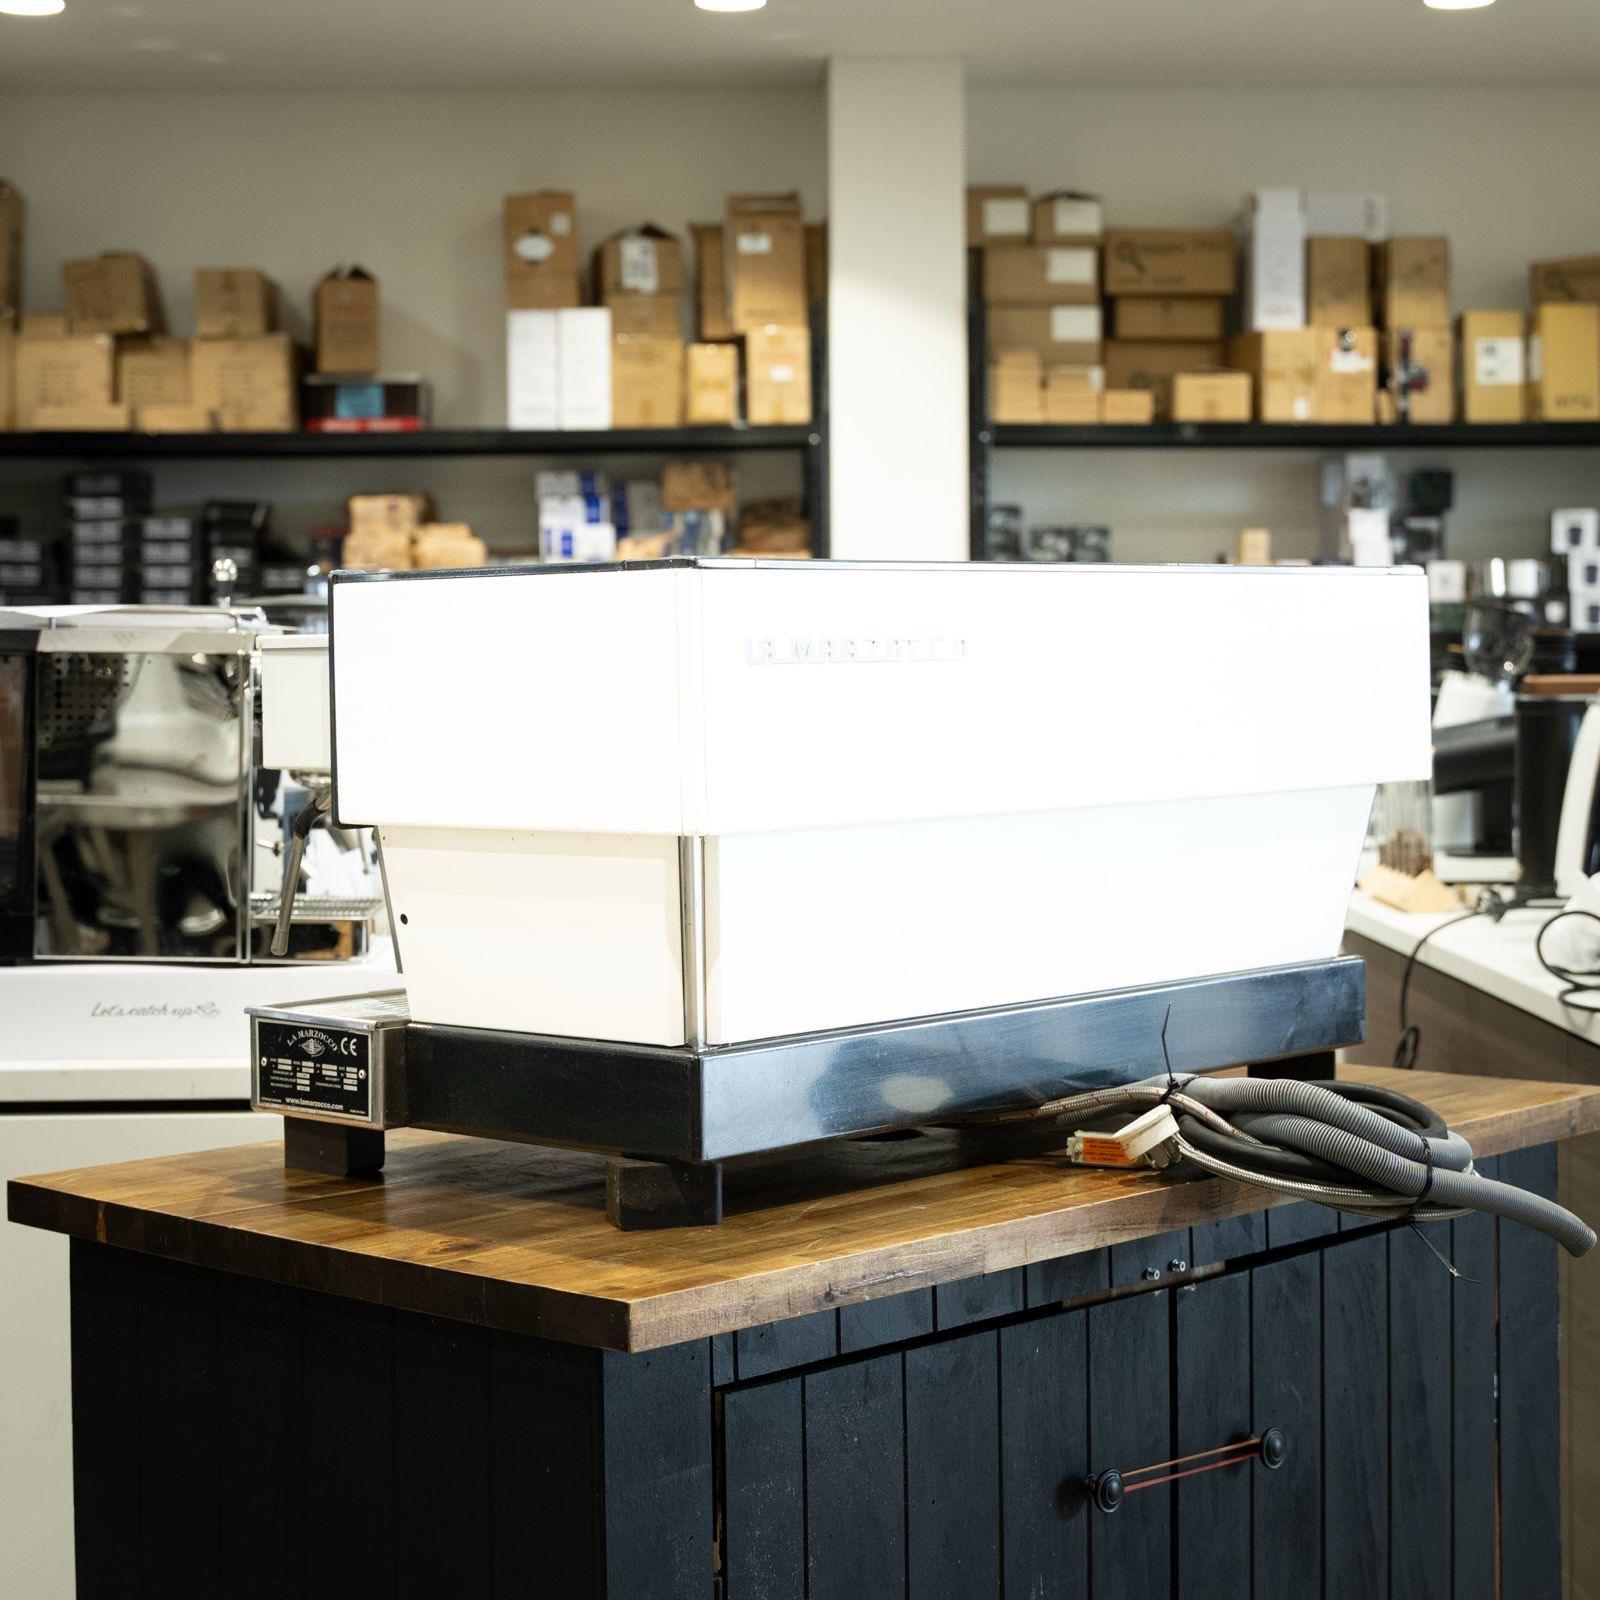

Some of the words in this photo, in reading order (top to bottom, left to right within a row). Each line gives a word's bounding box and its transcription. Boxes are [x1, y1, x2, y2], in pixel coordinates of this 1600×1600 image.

[128, 1002, 169, 1017] catch
[172, 1006, 193, 1018] up
[298, 1029, 338, 1052] MARZOCCO
